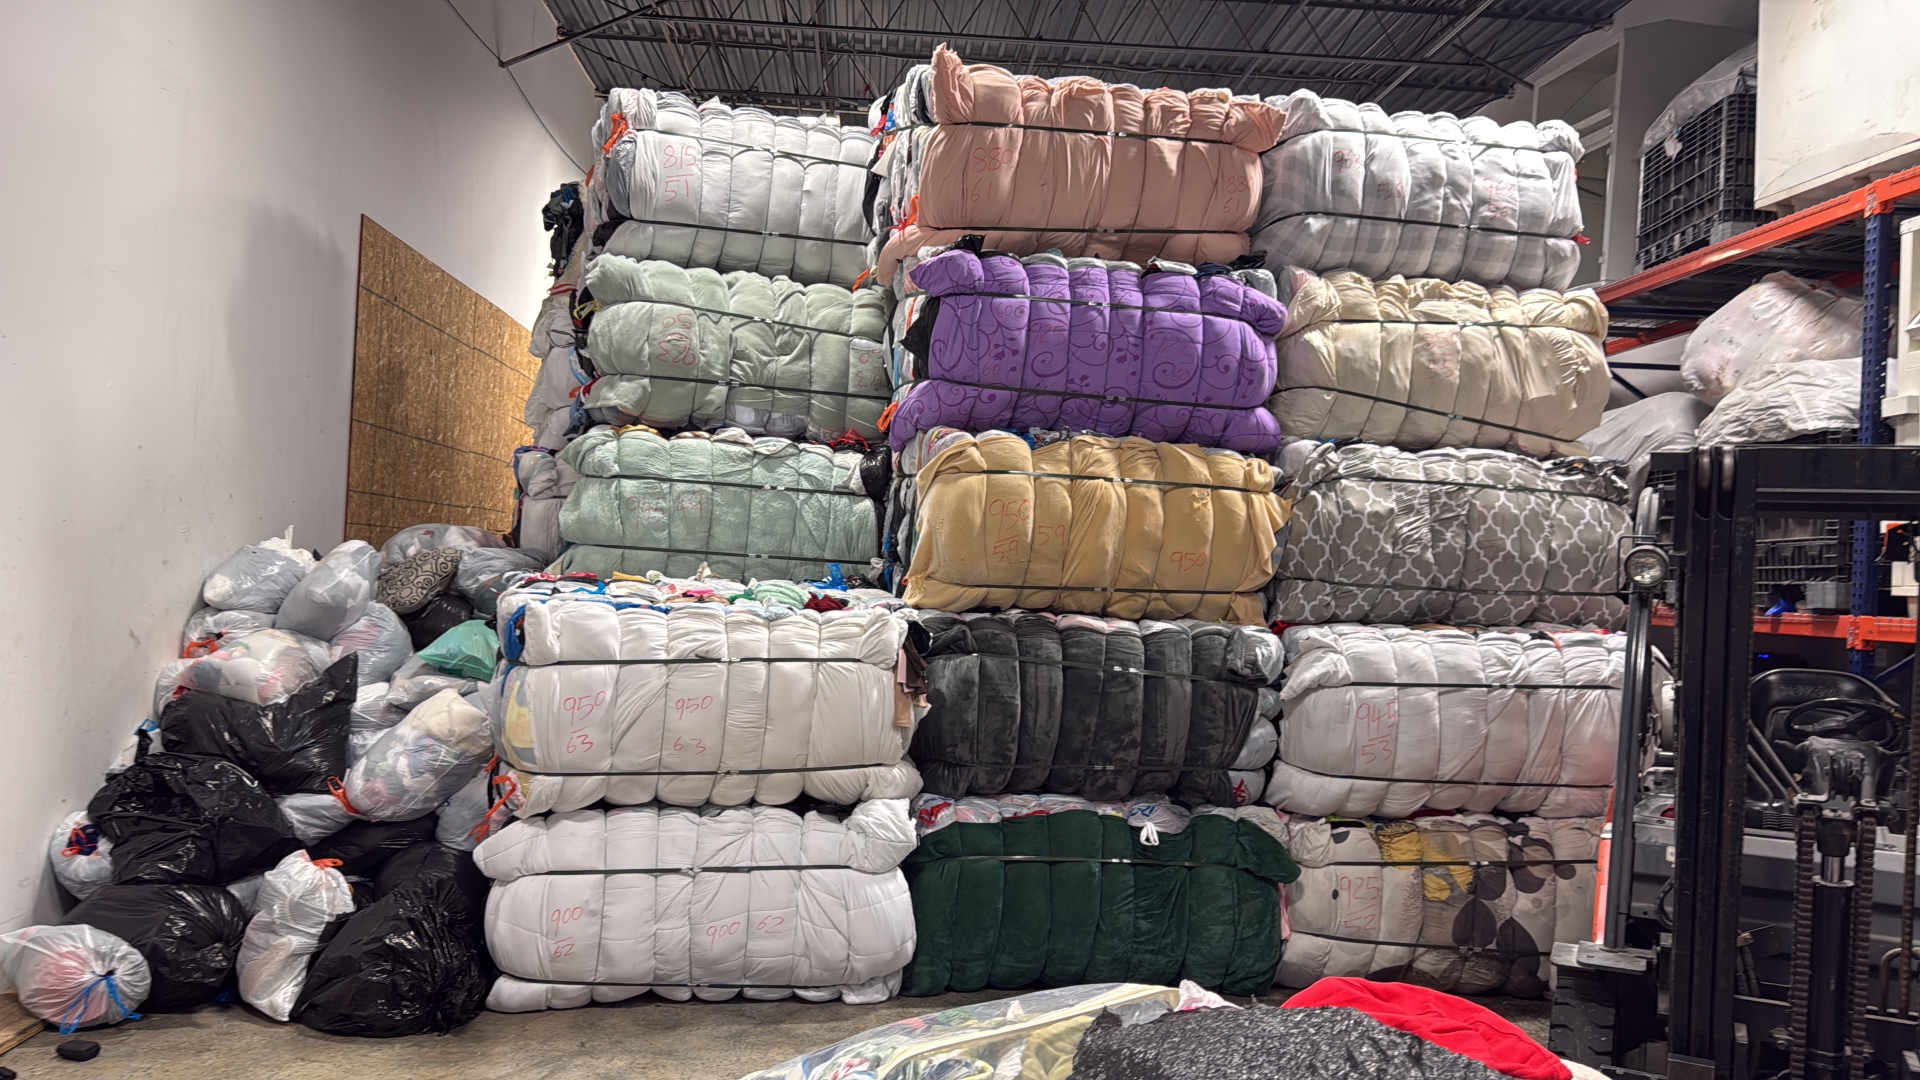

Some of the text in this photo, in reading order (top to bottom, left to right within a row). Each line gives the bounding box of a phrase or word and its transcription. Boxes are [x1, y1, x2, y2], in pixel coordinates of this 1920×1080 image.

[663, 144, 697, 170] 815
[972, 147, 1013, 172] 880
[665, 179, 689, 202] 51
[971, 177, 992, 203] 61
[1223, 197, 1240, 213] 61
[1031, 322, 1066, 352] 925
[1149, 331, 1196, 366] 925
[676, 492, 704, 521] 49
[989, 498, 1032, 539] 950
[1037, 524, 1066, 547] 59
[993, 540, 1019, 562] 59
[1170, 551, 1207, 573] 950
[563, 690, 606, 727] 950
[675, 695, 713, 720] 950
[1356, 700, 1397, 736] 945
[566, 733, 594, 754] 63
[673, 736, 707, 755] 63
[1361, 740, 1392, 765] 53
[1340, 876, 1381, 911] 925
[550, 906, 584, 937] 900
[706, 914, 785, 950] 900 62
[1343, 914, 1376, 935] 52
[553, 943, 575, 959] 62
